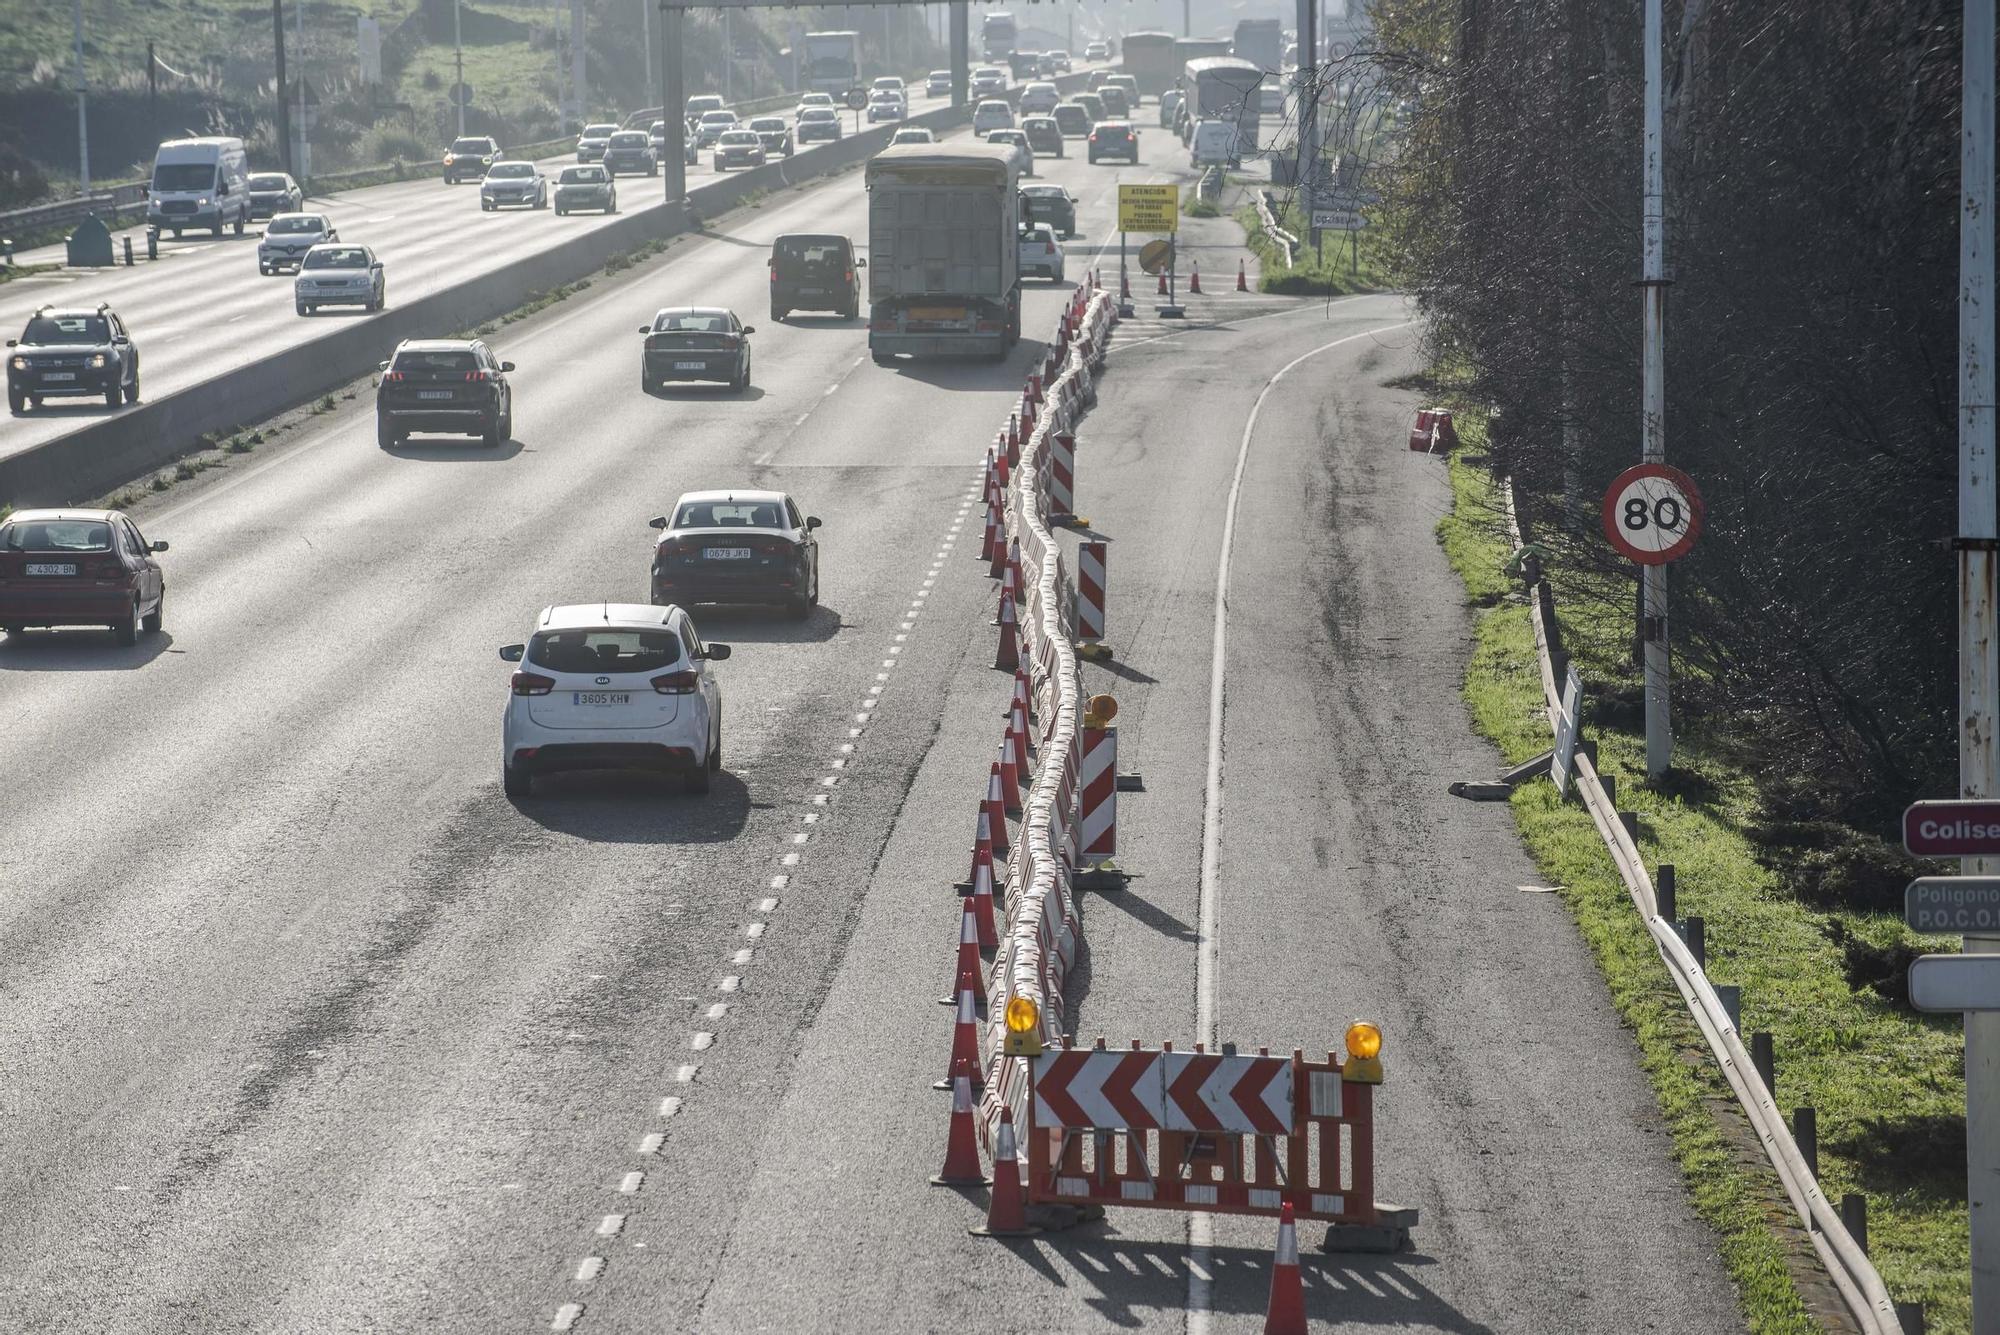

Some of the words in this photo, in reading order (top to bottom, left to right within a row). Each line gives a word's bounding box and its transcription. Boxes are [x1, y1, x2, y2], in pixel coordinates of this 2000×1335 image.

[1624, 497, 1680, 531] 80
[581, 694, 607, 704] 3605
[1918, 909, 2000, 927] P.O.C.O.
